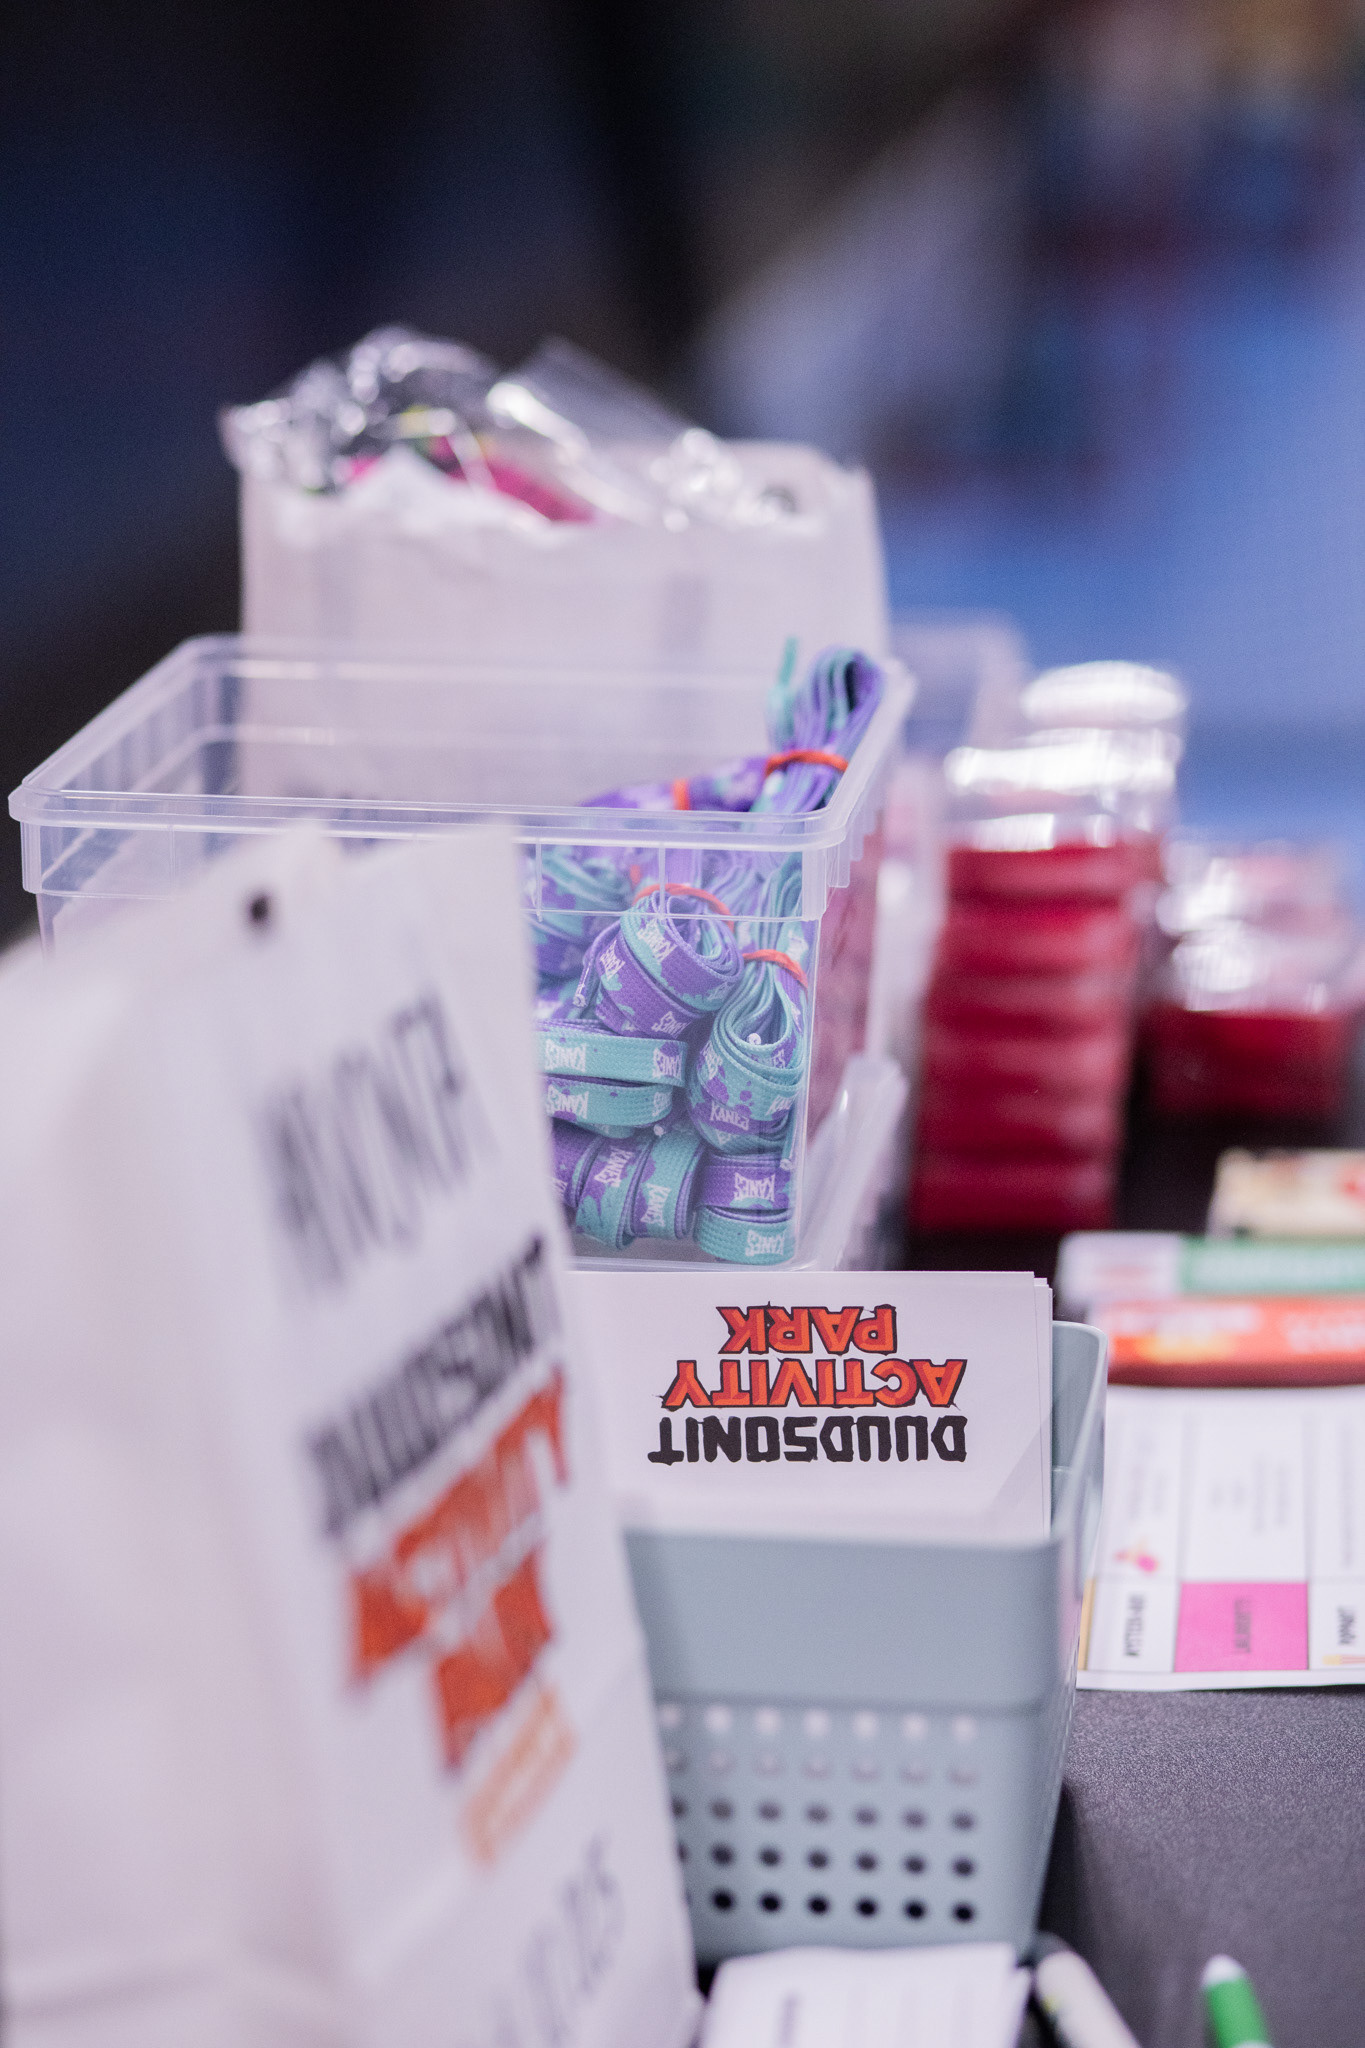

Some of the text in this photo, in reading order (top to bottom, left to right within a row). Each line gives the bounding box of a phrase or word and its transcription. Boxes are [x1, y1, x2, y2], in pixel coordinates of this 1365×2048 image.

[734, 1172, 776, 1202] KANES
[716, 1302, 898, 1355] PARK
[660, 1358, 968, 1411] ACTIVITY
[648, 1415, 968, 1466] DUUDSONIT
